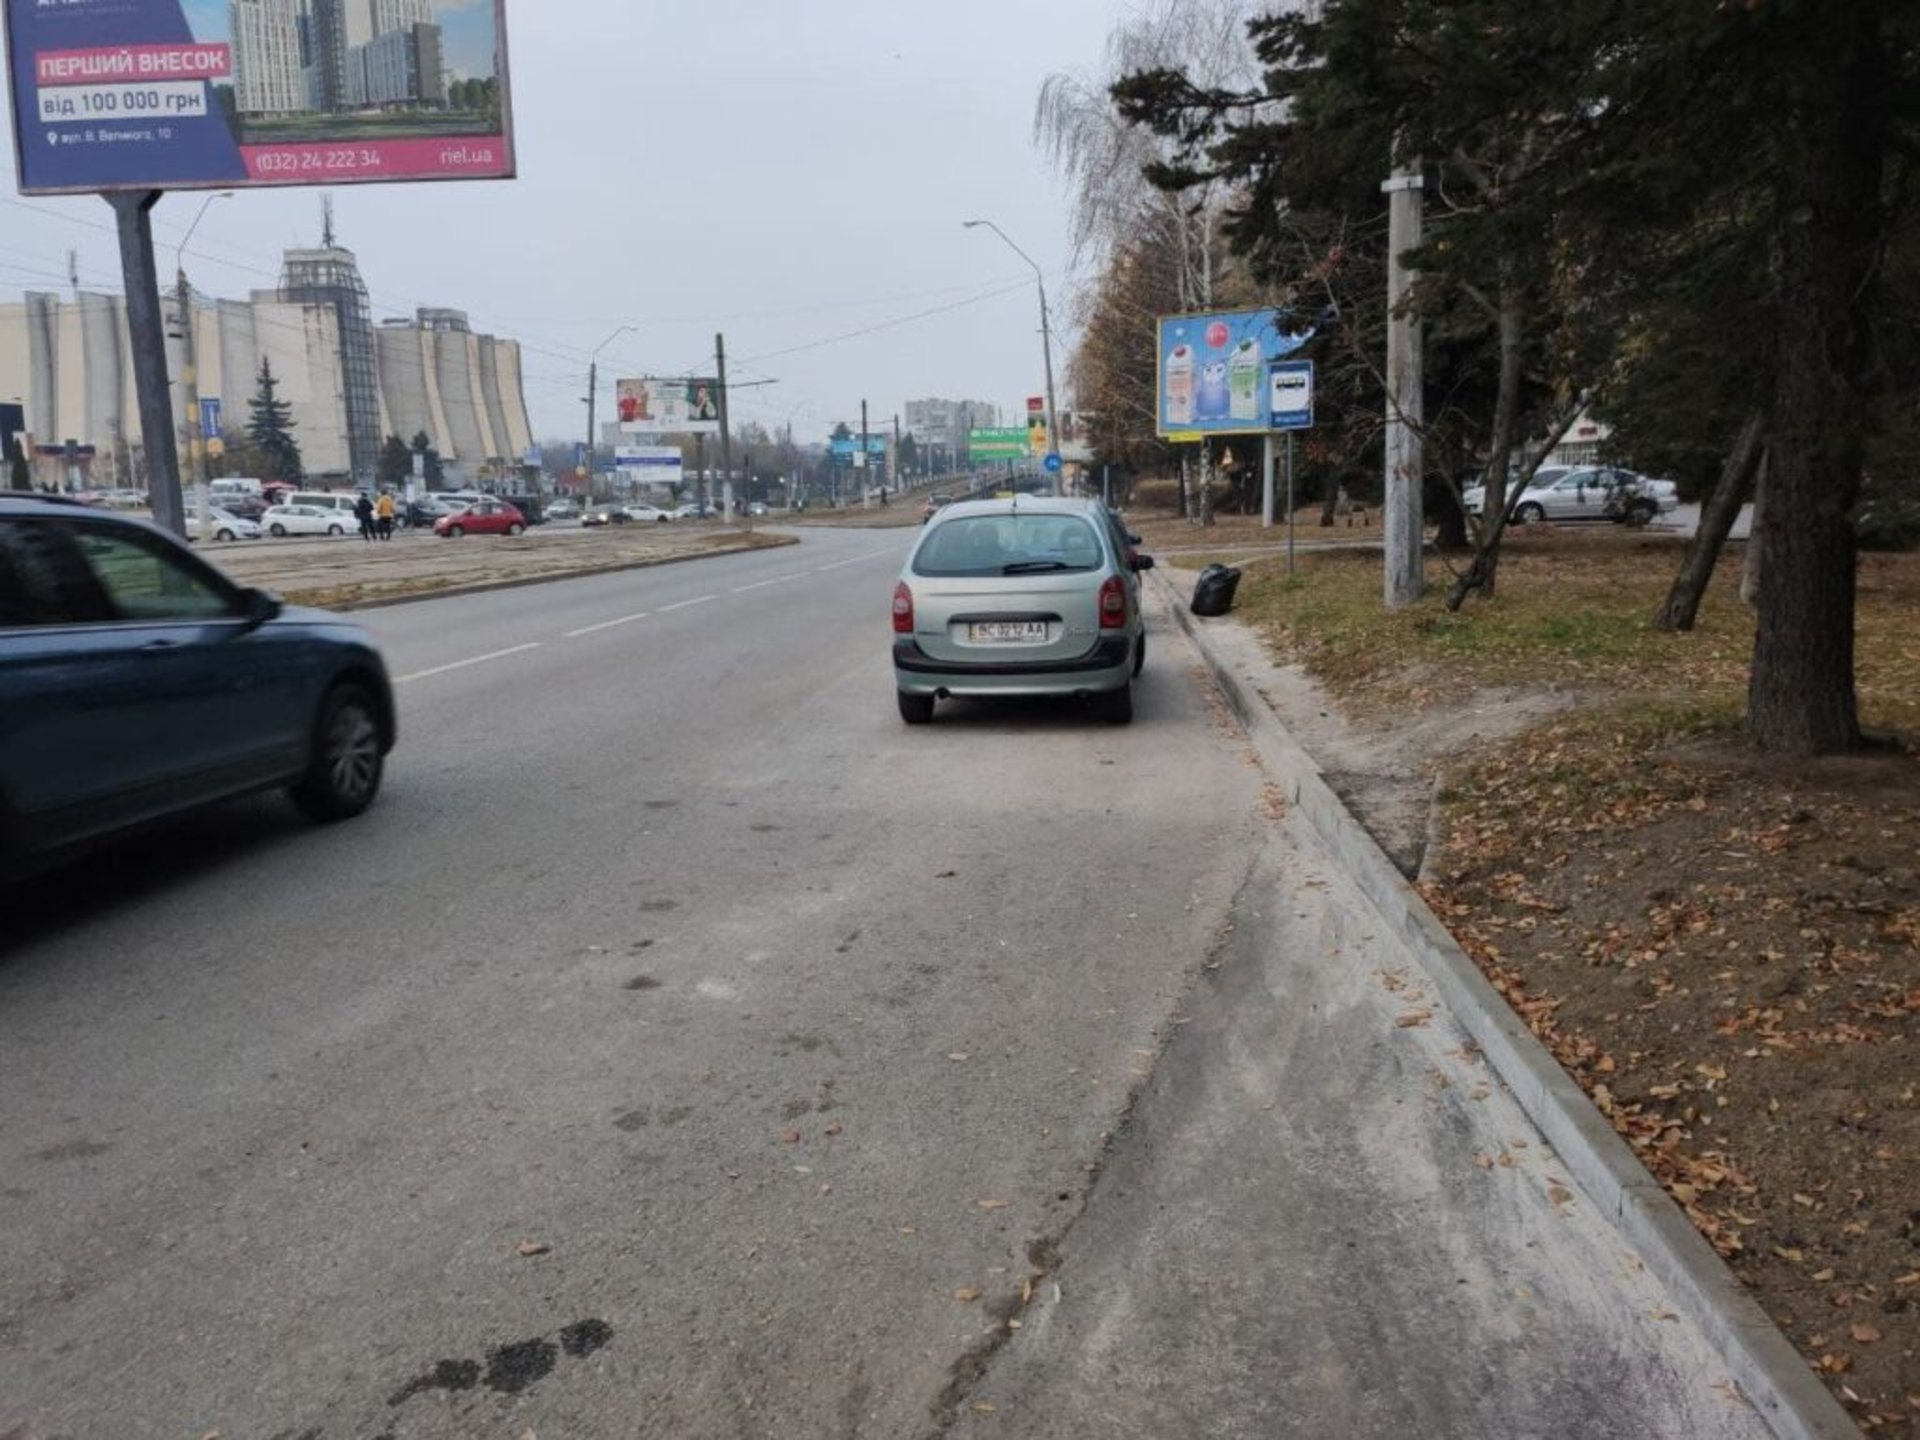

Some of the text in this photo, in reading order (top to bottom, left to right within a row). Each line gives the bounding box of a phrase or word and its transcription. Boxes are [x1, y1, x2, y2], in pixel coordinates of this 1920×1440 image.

[40, 50, 225, 77] ПЕРШИЙ ВНЕСОК
[44, 91, 200, 115] від 100 000 грн
[158, 127, 171, 139] 10
[256, 150, 381, 173] (032) 24 222 34
[440, 147, 493, 164] riel.ua
